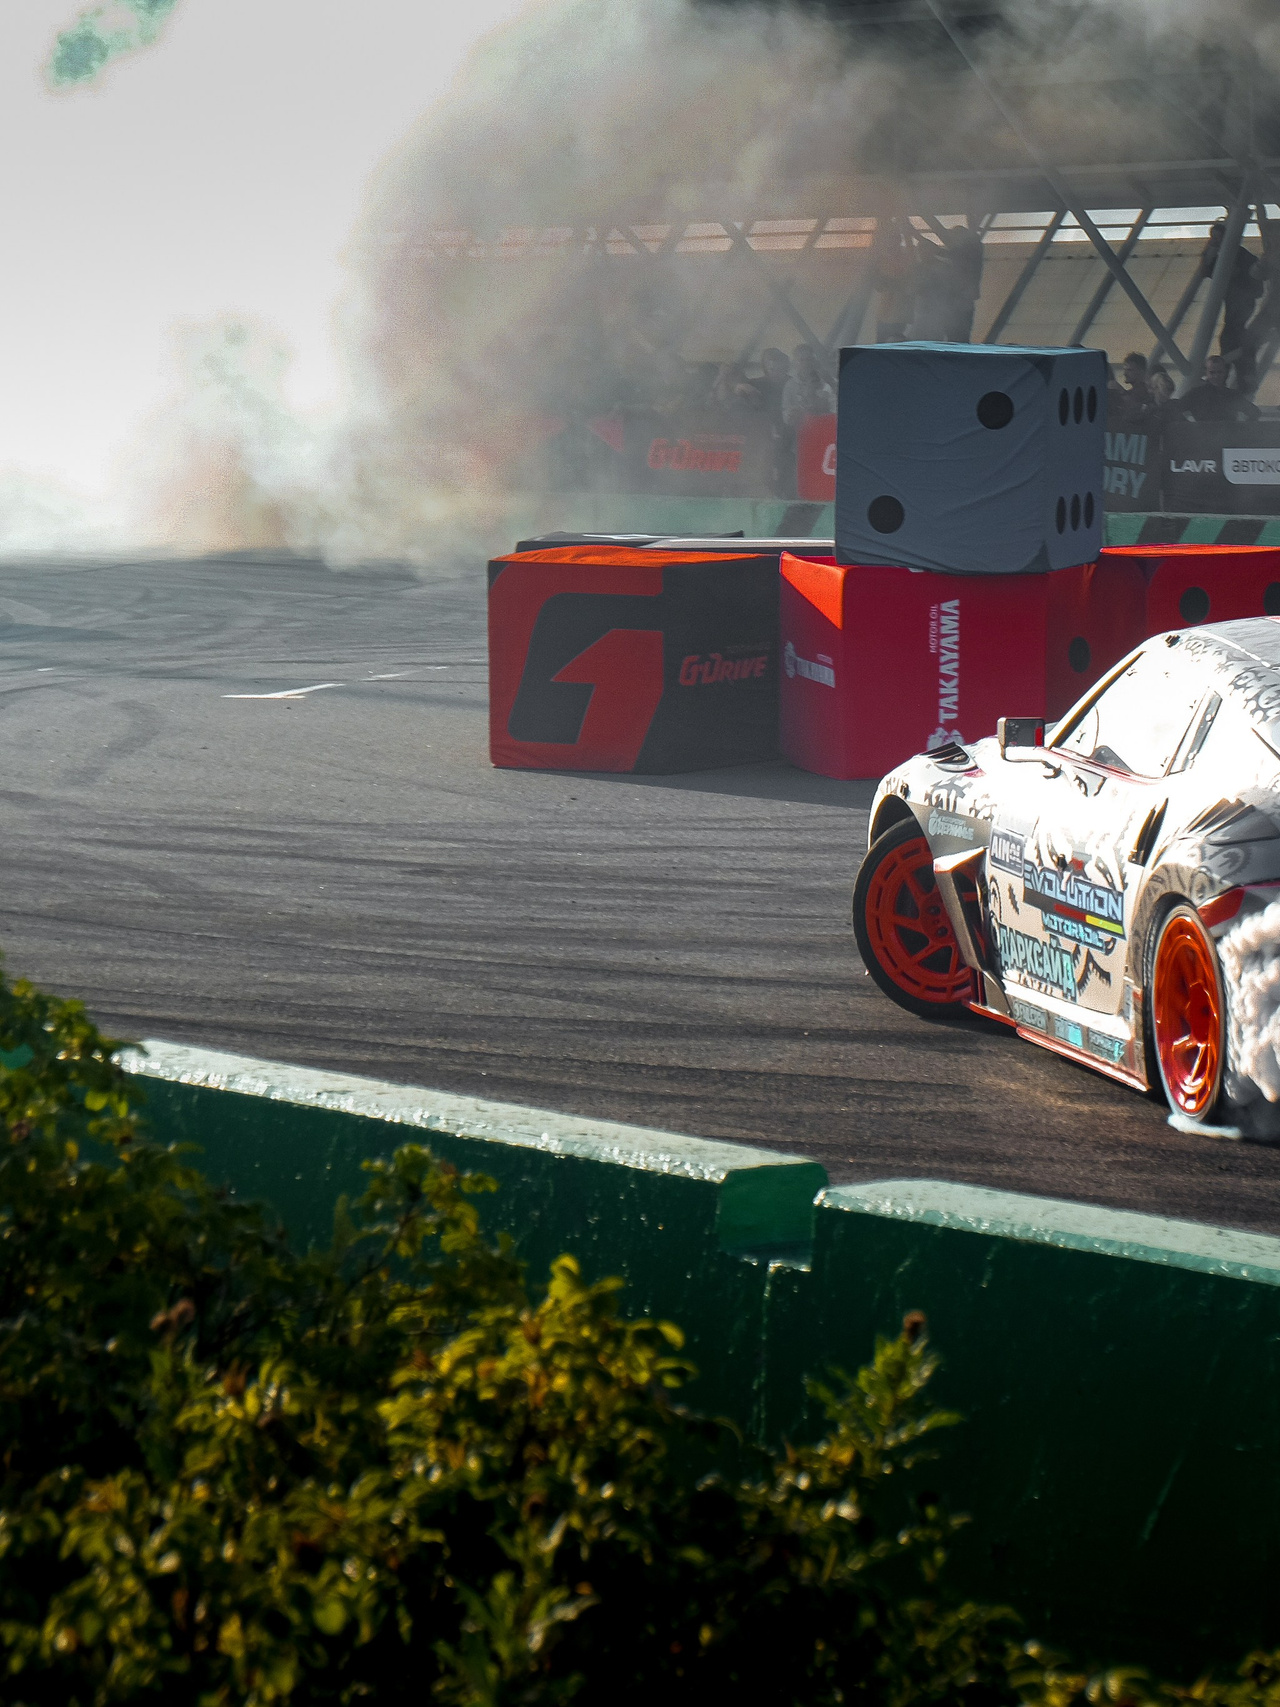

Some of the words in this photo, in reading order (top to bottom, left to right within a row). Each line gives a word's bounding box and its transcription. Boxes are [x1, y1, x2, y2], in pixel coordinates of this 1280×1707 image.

[1170, 460, 1217, 473] LAVR
[938, 599, 960, 724] TAKAYAMA
[1025, 863, 1123, 921] EVOLUTION
[1001, 926, 1077, 999] ДАРКСАЙД
